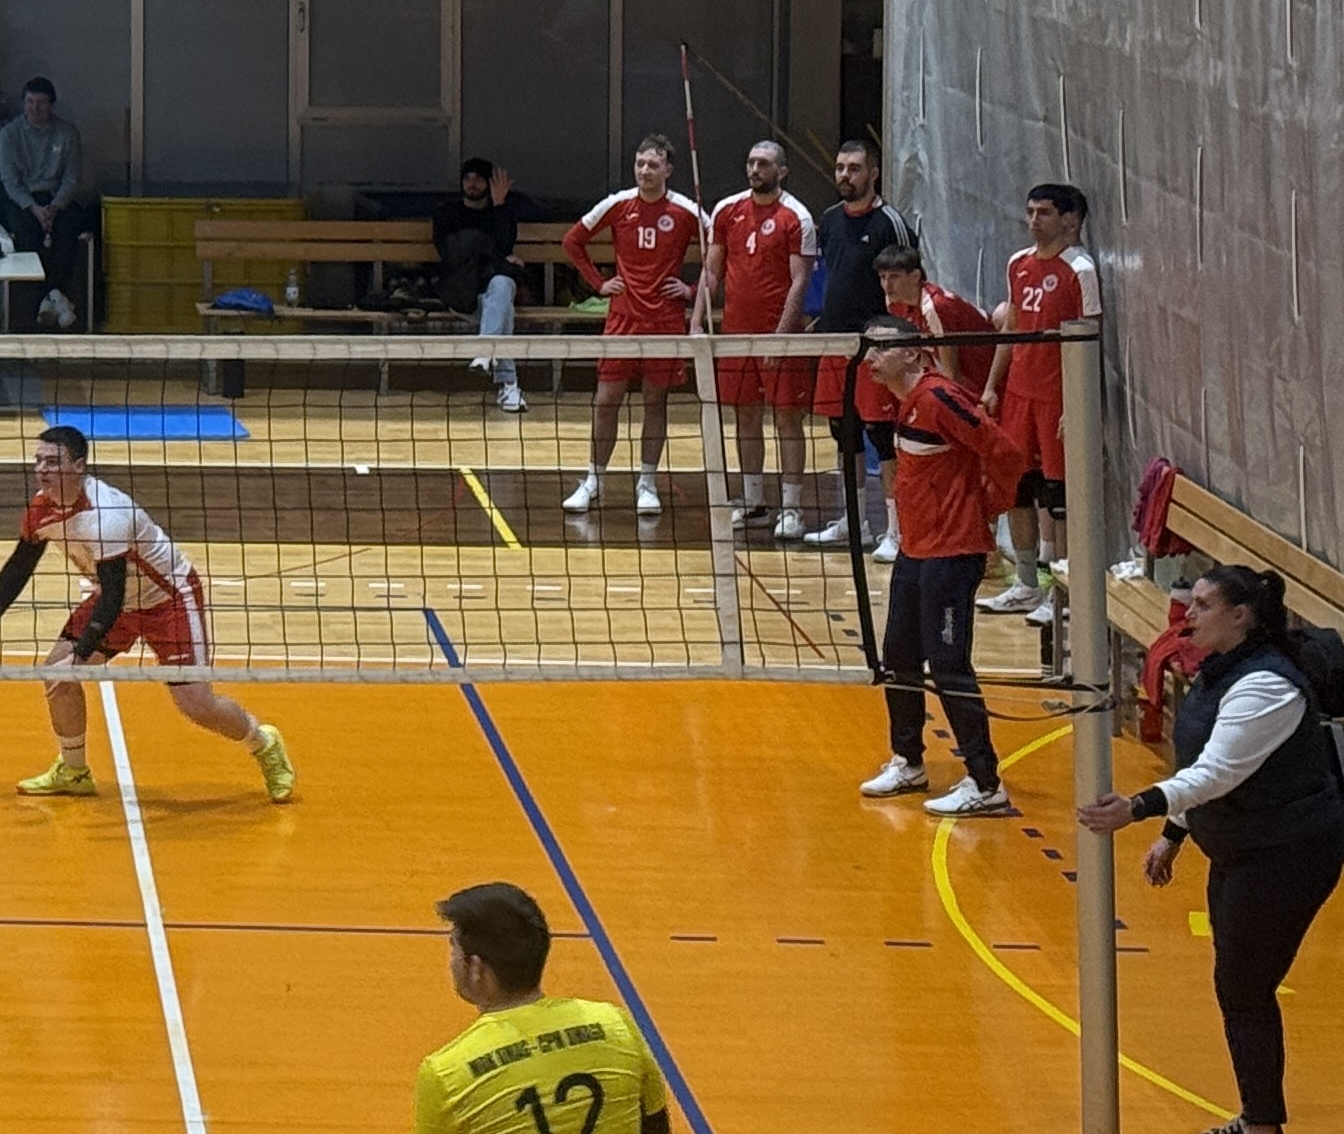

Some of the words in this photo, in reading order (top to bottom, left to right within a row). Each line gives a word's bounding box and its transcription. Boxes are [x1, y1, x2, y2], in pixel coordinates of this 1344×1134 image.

[637, 226, 656, 249] 19
[745, 231, 756, 255] 4
[1022, 286, 1043, 313] 22
